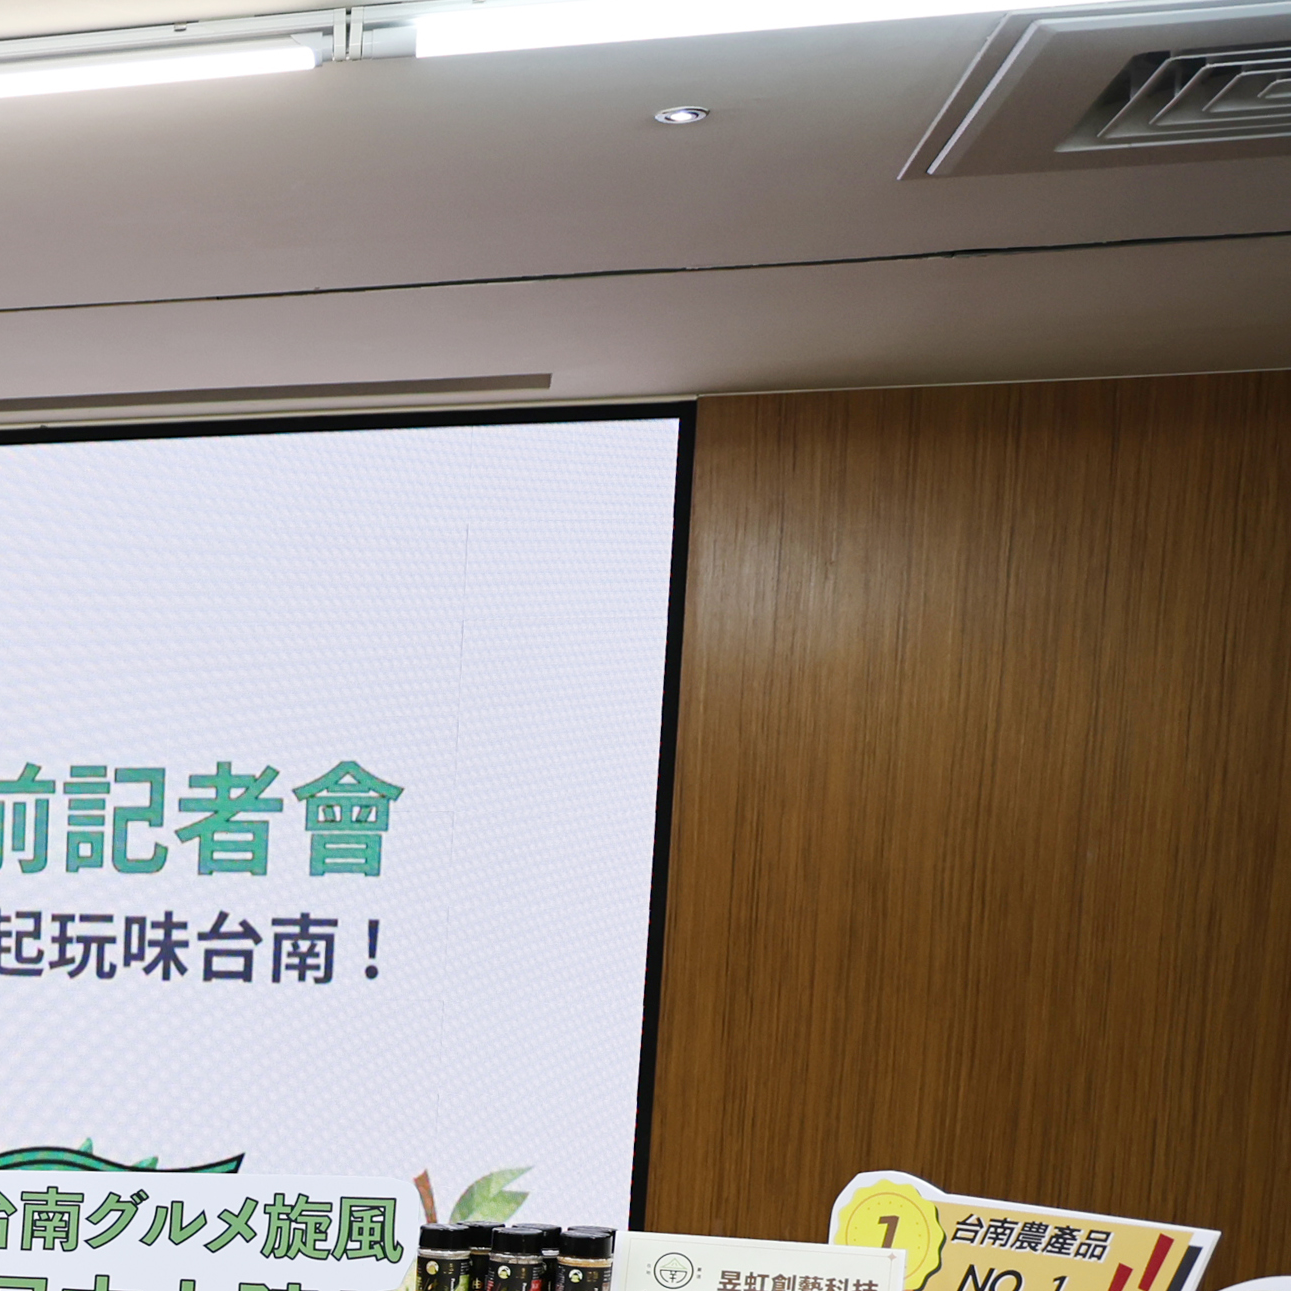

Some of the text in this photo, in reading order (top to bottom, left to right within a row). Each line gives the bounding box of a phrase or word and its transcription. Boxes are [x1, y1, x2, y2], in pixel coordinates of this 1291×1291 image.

[951, 1213, 1111, 1260] 台南農產品
